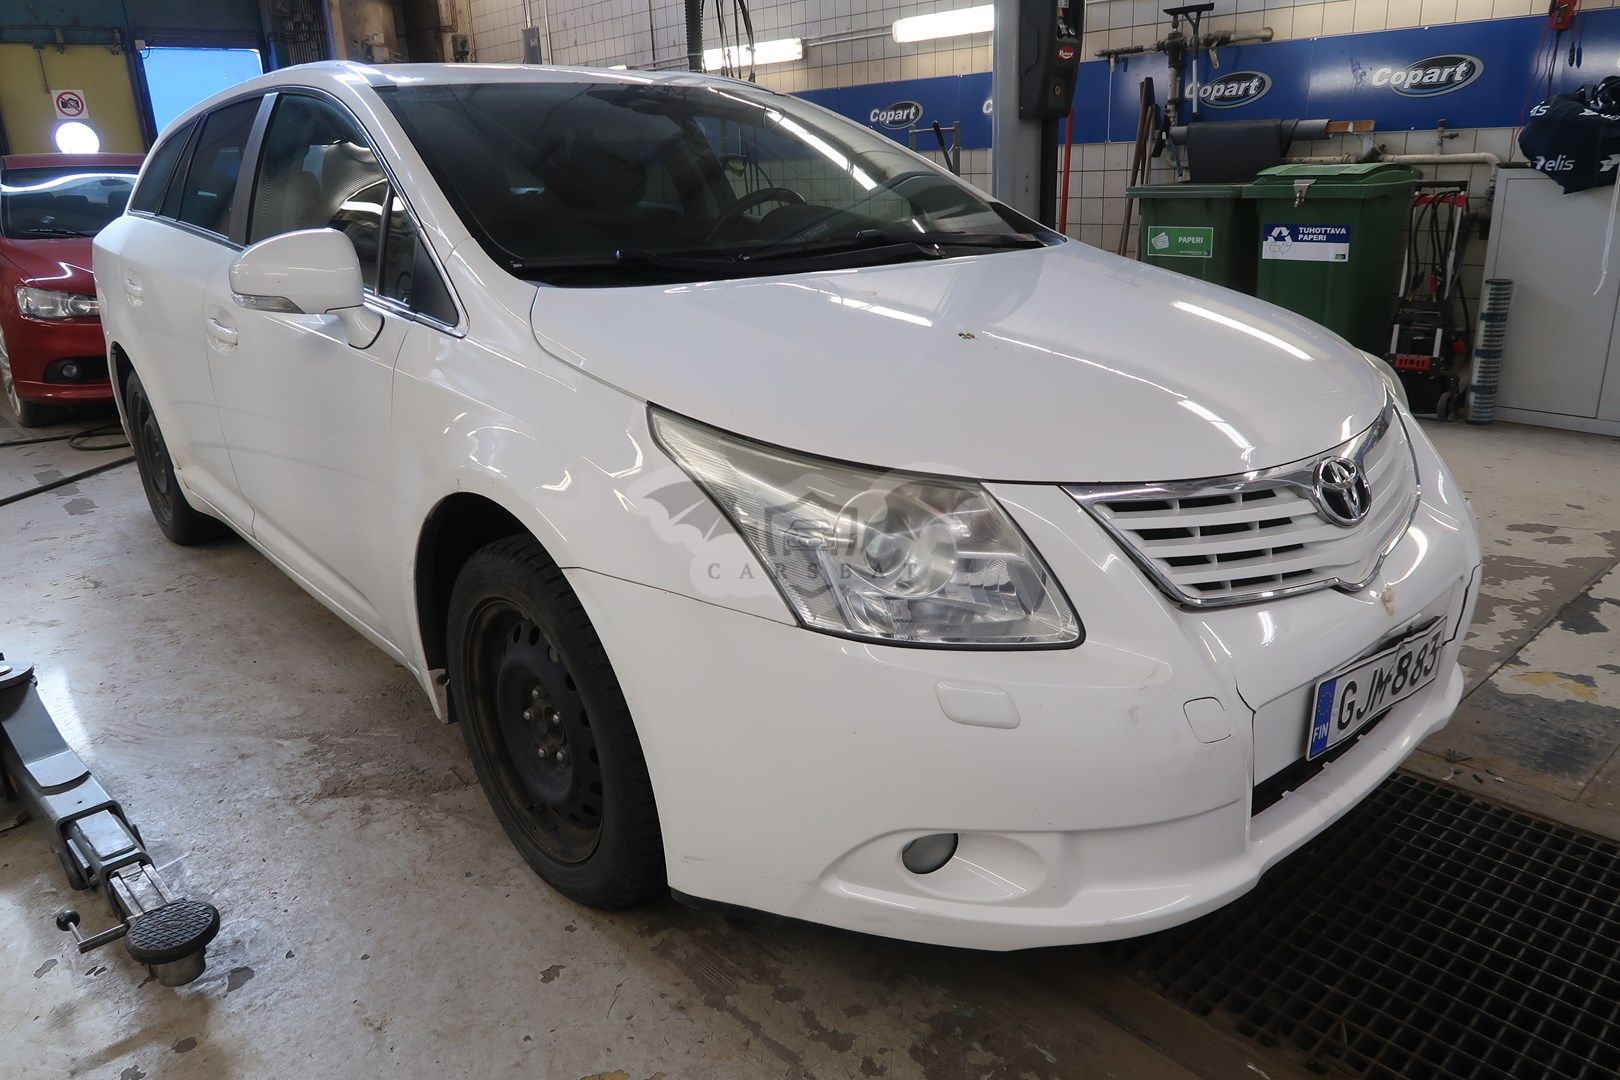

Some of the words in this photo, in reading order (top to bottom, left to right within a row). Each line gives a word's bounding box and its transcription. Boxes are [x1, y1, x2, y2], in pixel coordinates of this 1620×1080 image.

[1372, 59, 1471, 88] Copart
[1184, 74, 1260, 101] Copart
[869, 105, 916, 123] Copart
[1544, 154, 1575, 171] elis
[1178, 236, 1204, 244] PAPERI
[1298, 227, 1347, 235] TUHOTTAVA
[1313, 722, 1330, 743] FIN
